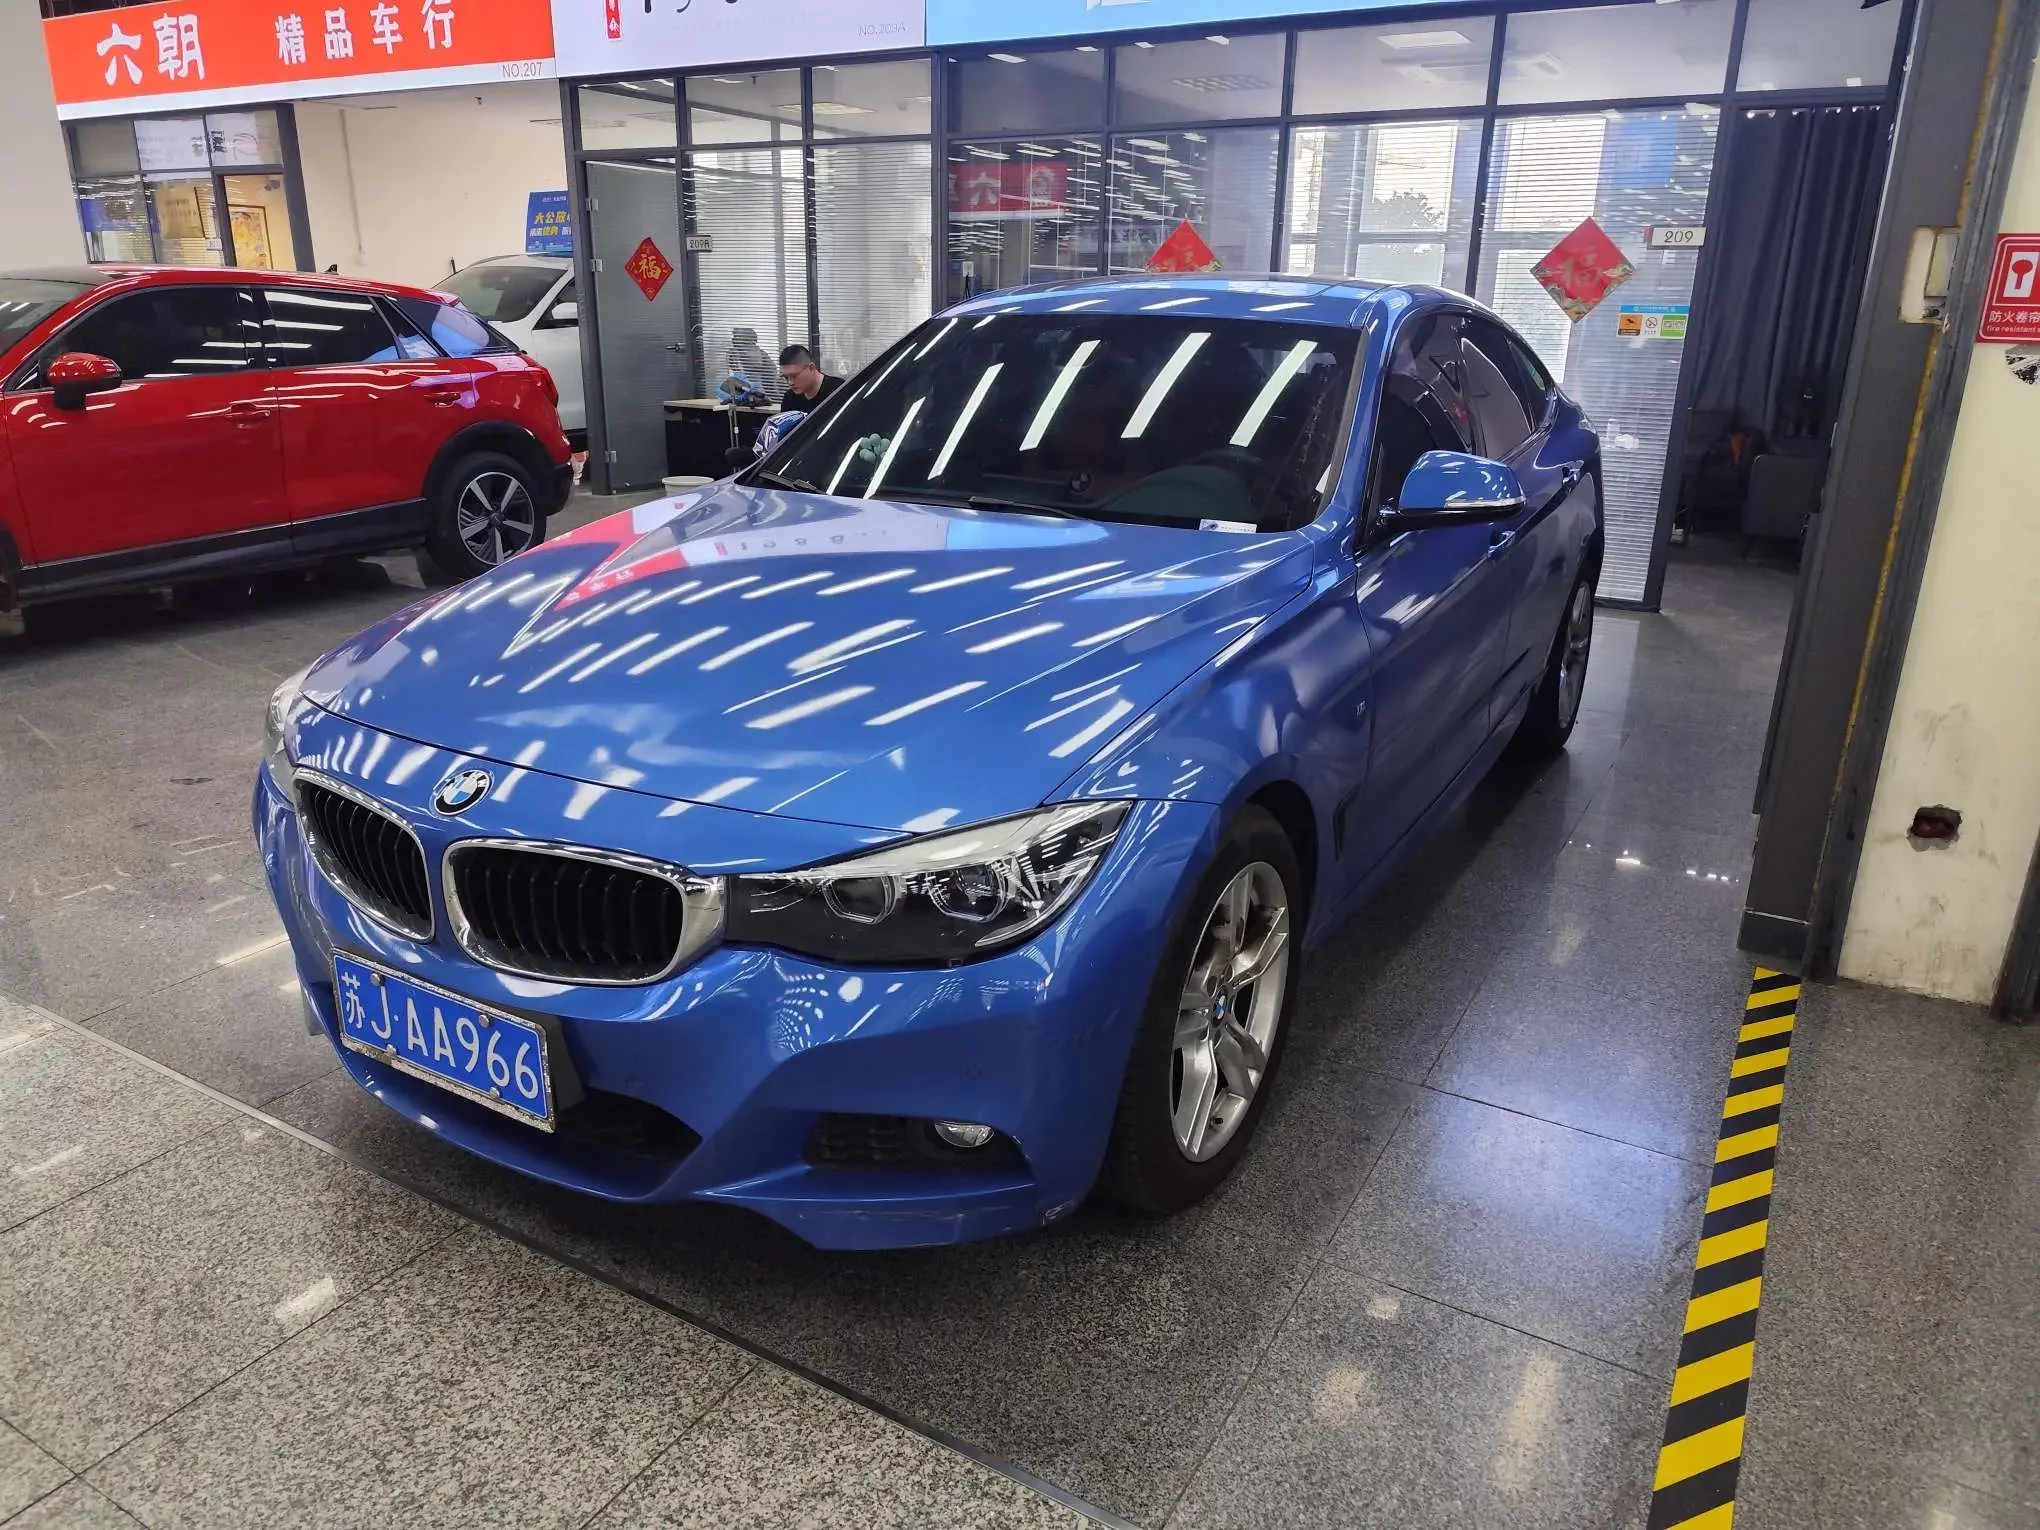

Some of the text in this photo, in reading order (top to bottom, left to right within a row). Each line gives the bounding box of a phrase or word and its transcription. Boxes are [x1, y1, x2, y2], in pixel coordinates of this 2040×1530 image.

[96, 0, 455, 86] 六朝 精品车行
[502, 62, 542, 78] NO.207
[1664, 230, 1694, 244] 209
[638, 253, 661, 280] 福
